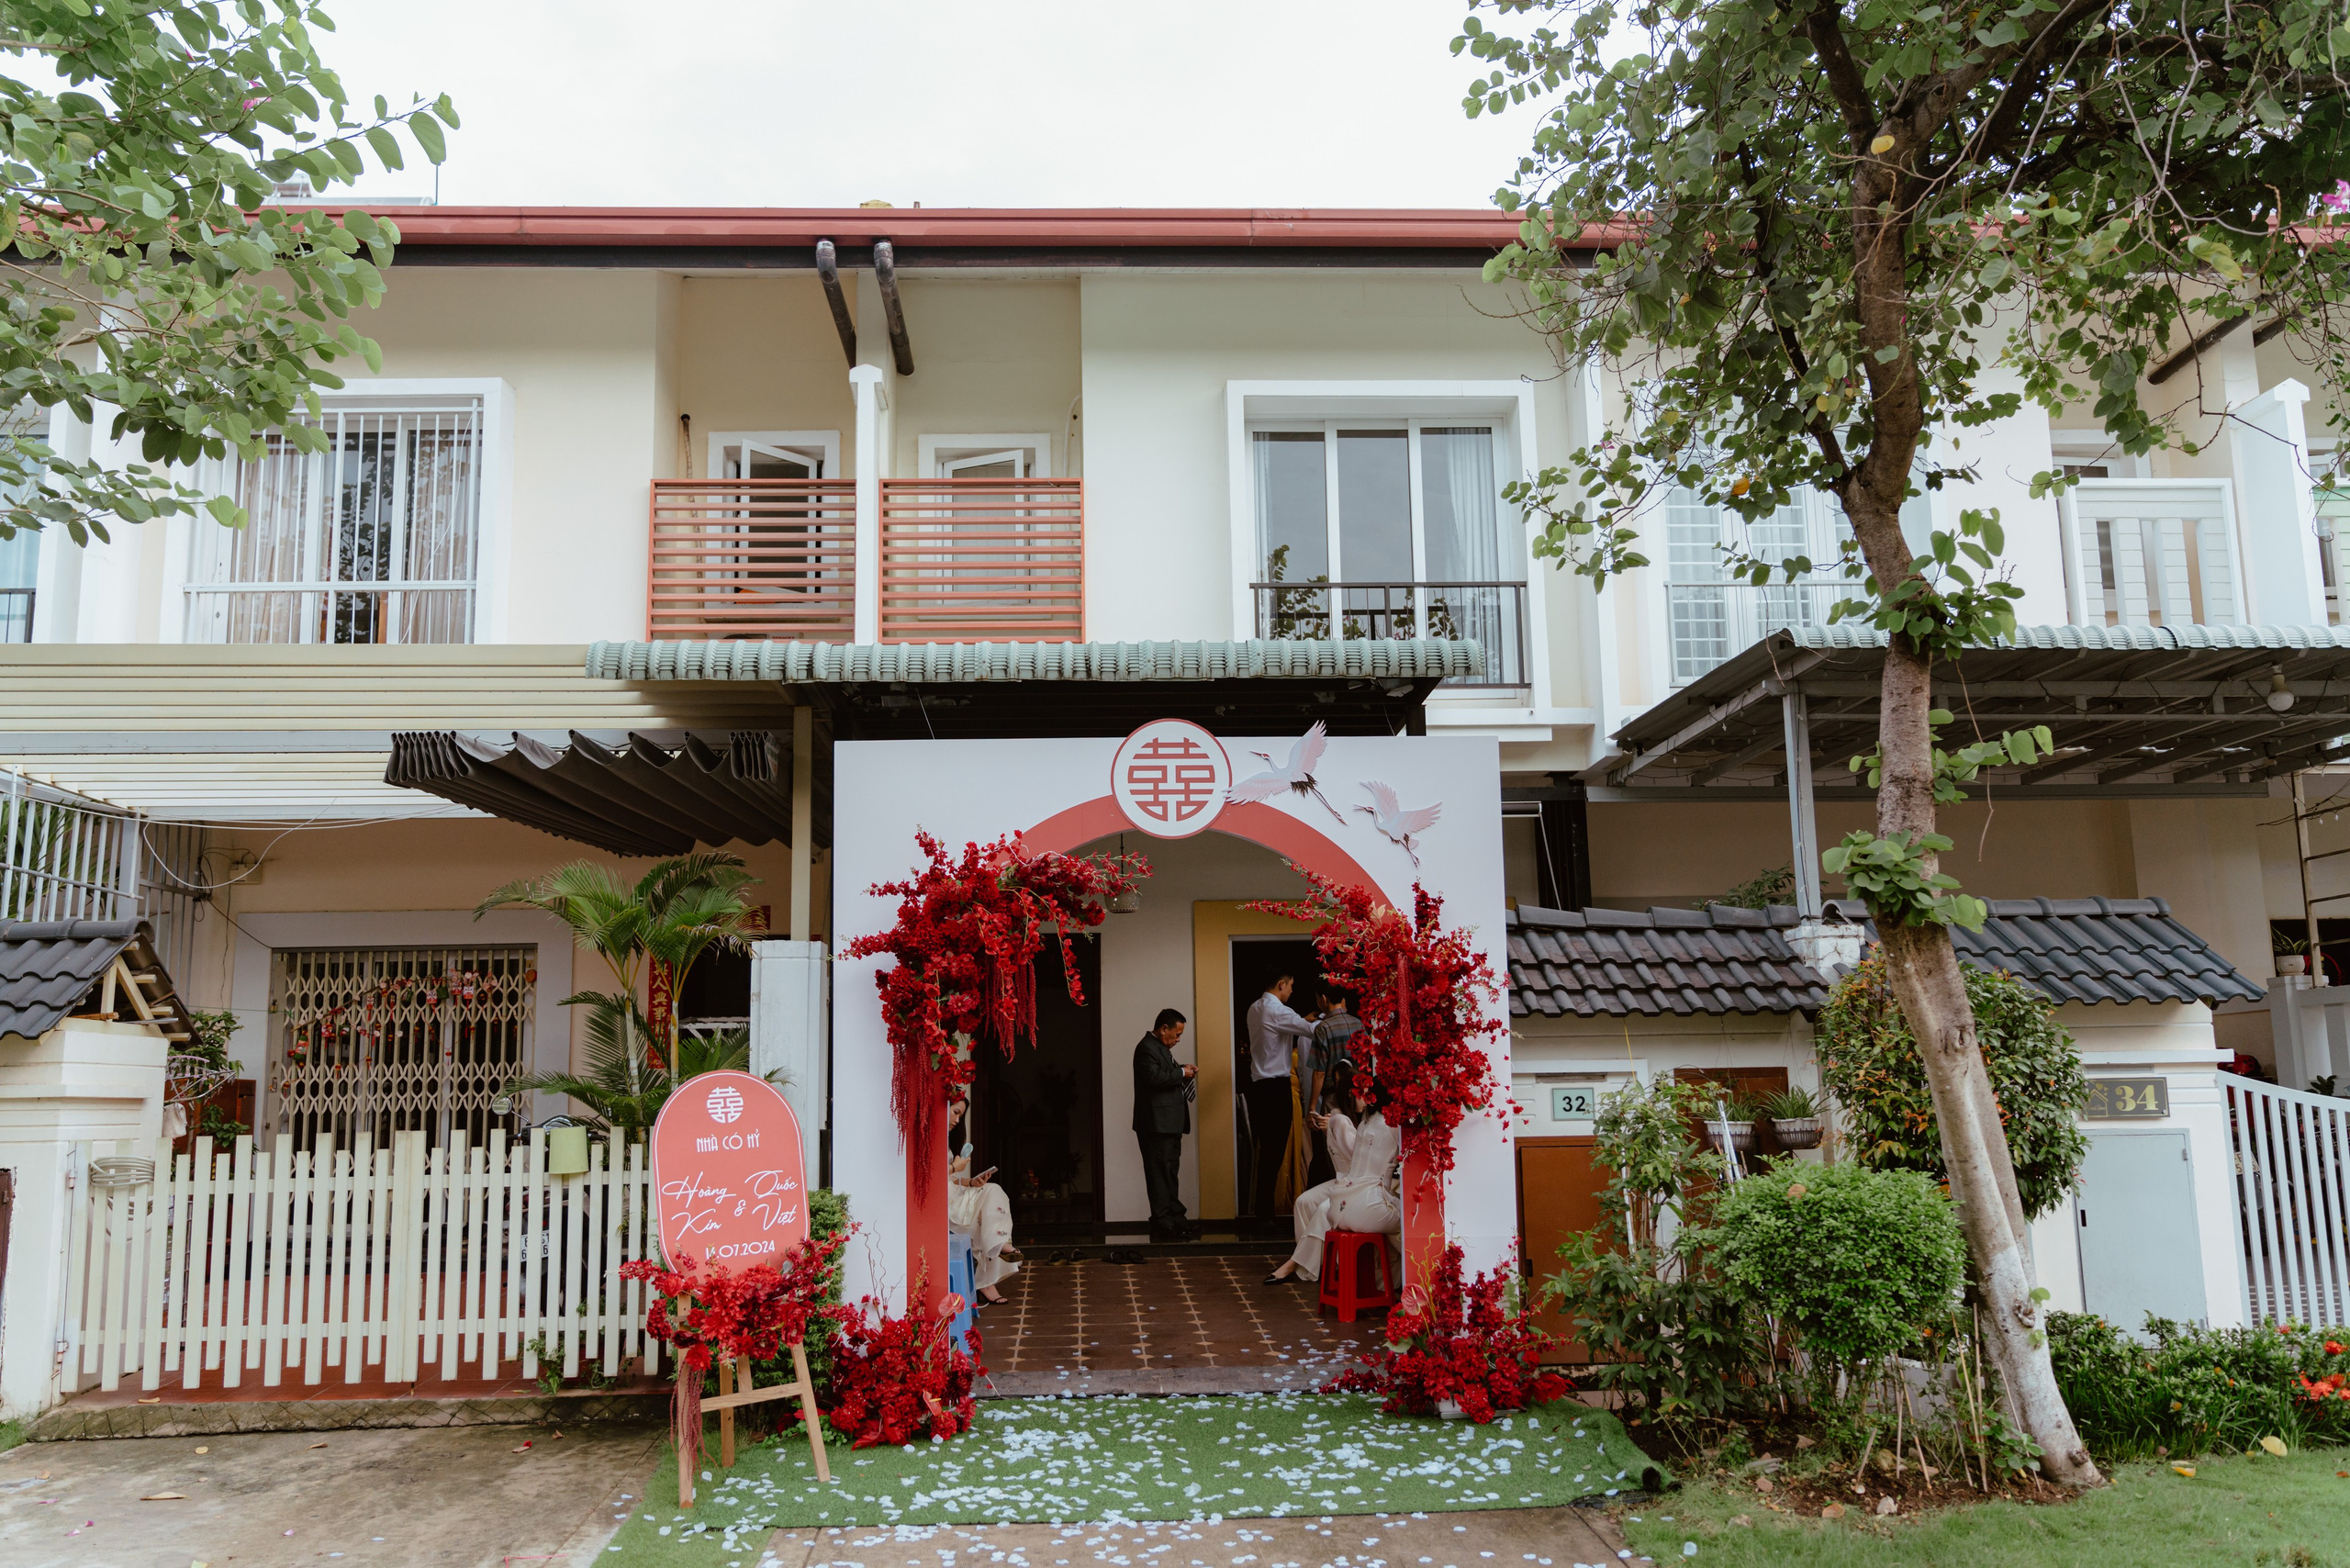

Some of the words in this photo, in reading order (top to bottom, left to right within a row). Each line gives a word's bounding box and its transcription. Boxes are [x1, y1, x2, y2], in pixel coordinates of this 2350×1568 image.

[1561, 1095, 1586, 1113] 32
[2115, 1084, 2159, 1112] 34
[696, 1134, 719, 1153] NHÀ
[722, 1131, 744, 1150] CÓ
[747, 1128, 761, 1148] HỶ
[661, 1170, 737, 1209] Hoàng
[744, 1170, 799, 1200] Quốc
[671, 1208, 722, 1241] Kim
[751, 1197, 798, 1231] Việt
[733, 1199, 747, 1217] &
